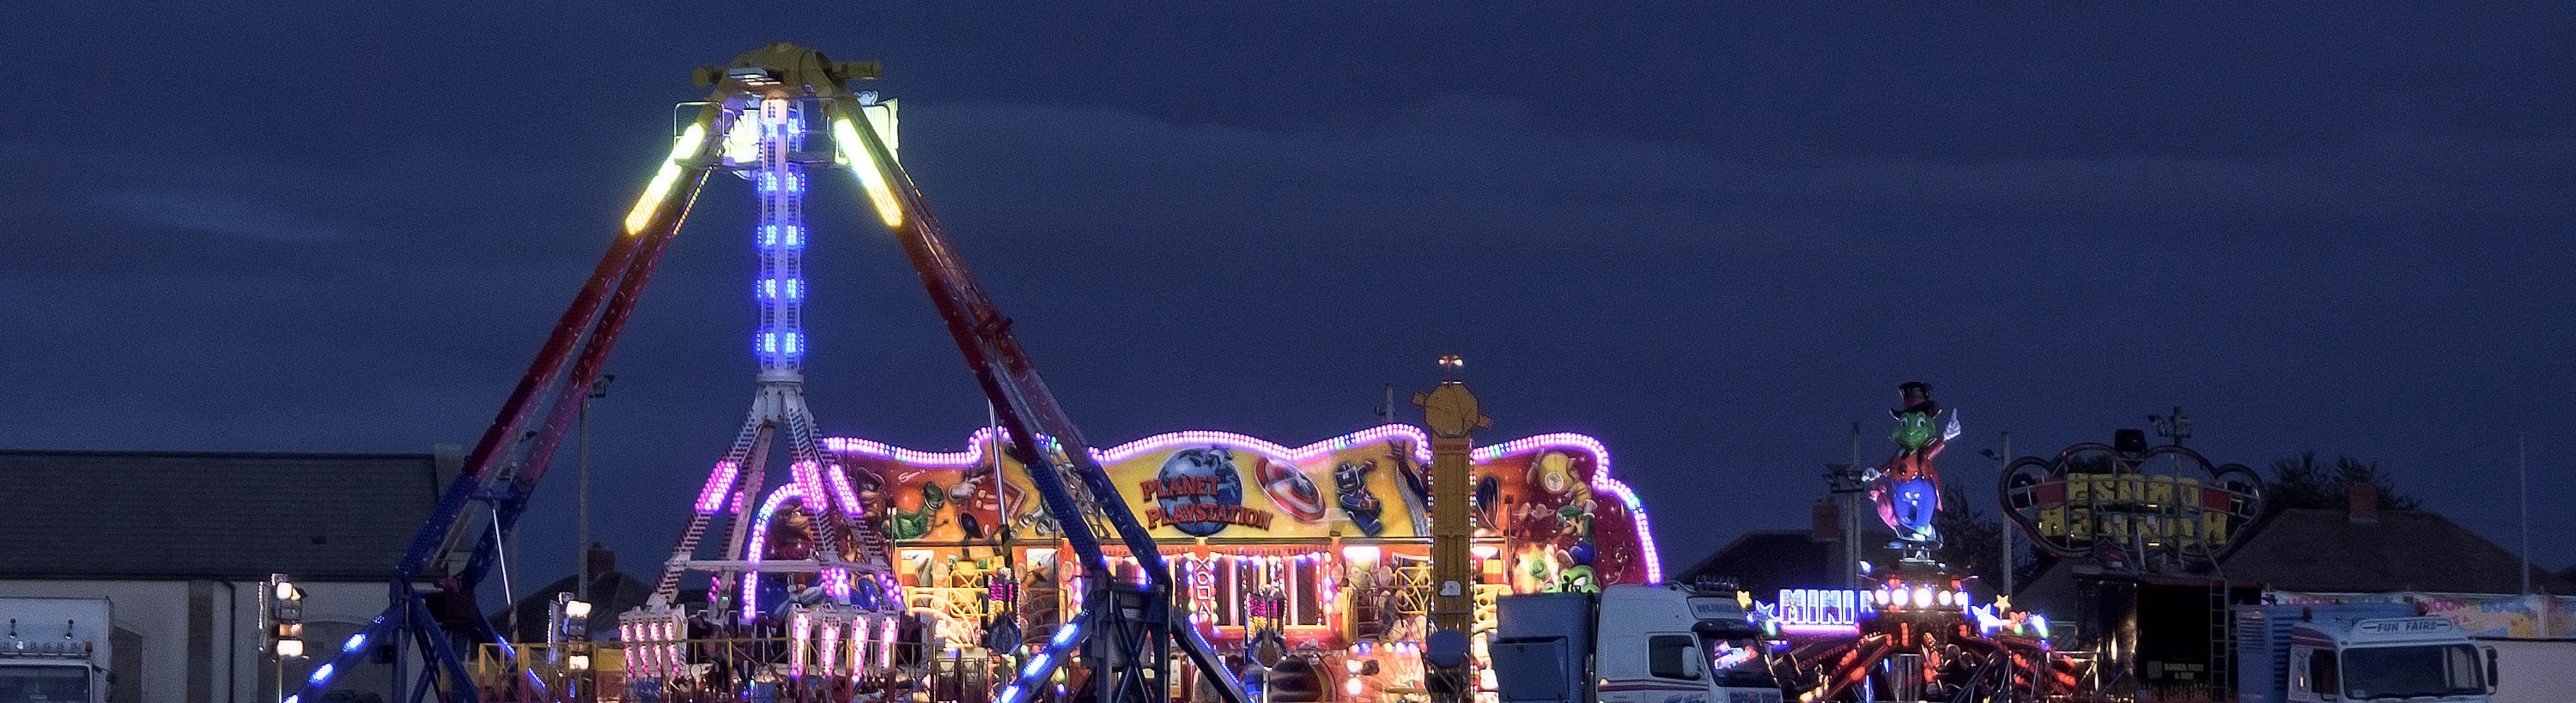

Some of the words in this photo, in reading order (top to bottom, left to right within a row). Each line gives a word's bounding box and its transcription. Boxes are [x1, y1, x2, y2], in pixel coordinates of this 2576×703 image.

[1140, 475, 1220, 503] PLANET
[1146, 503, 1273, 530] PLAYSTATION
[1780, 589, 1855, 625] MINI
[2377, 623, 2399, 632] FUN
[2405, 621, 2437, 631] FAIRS
